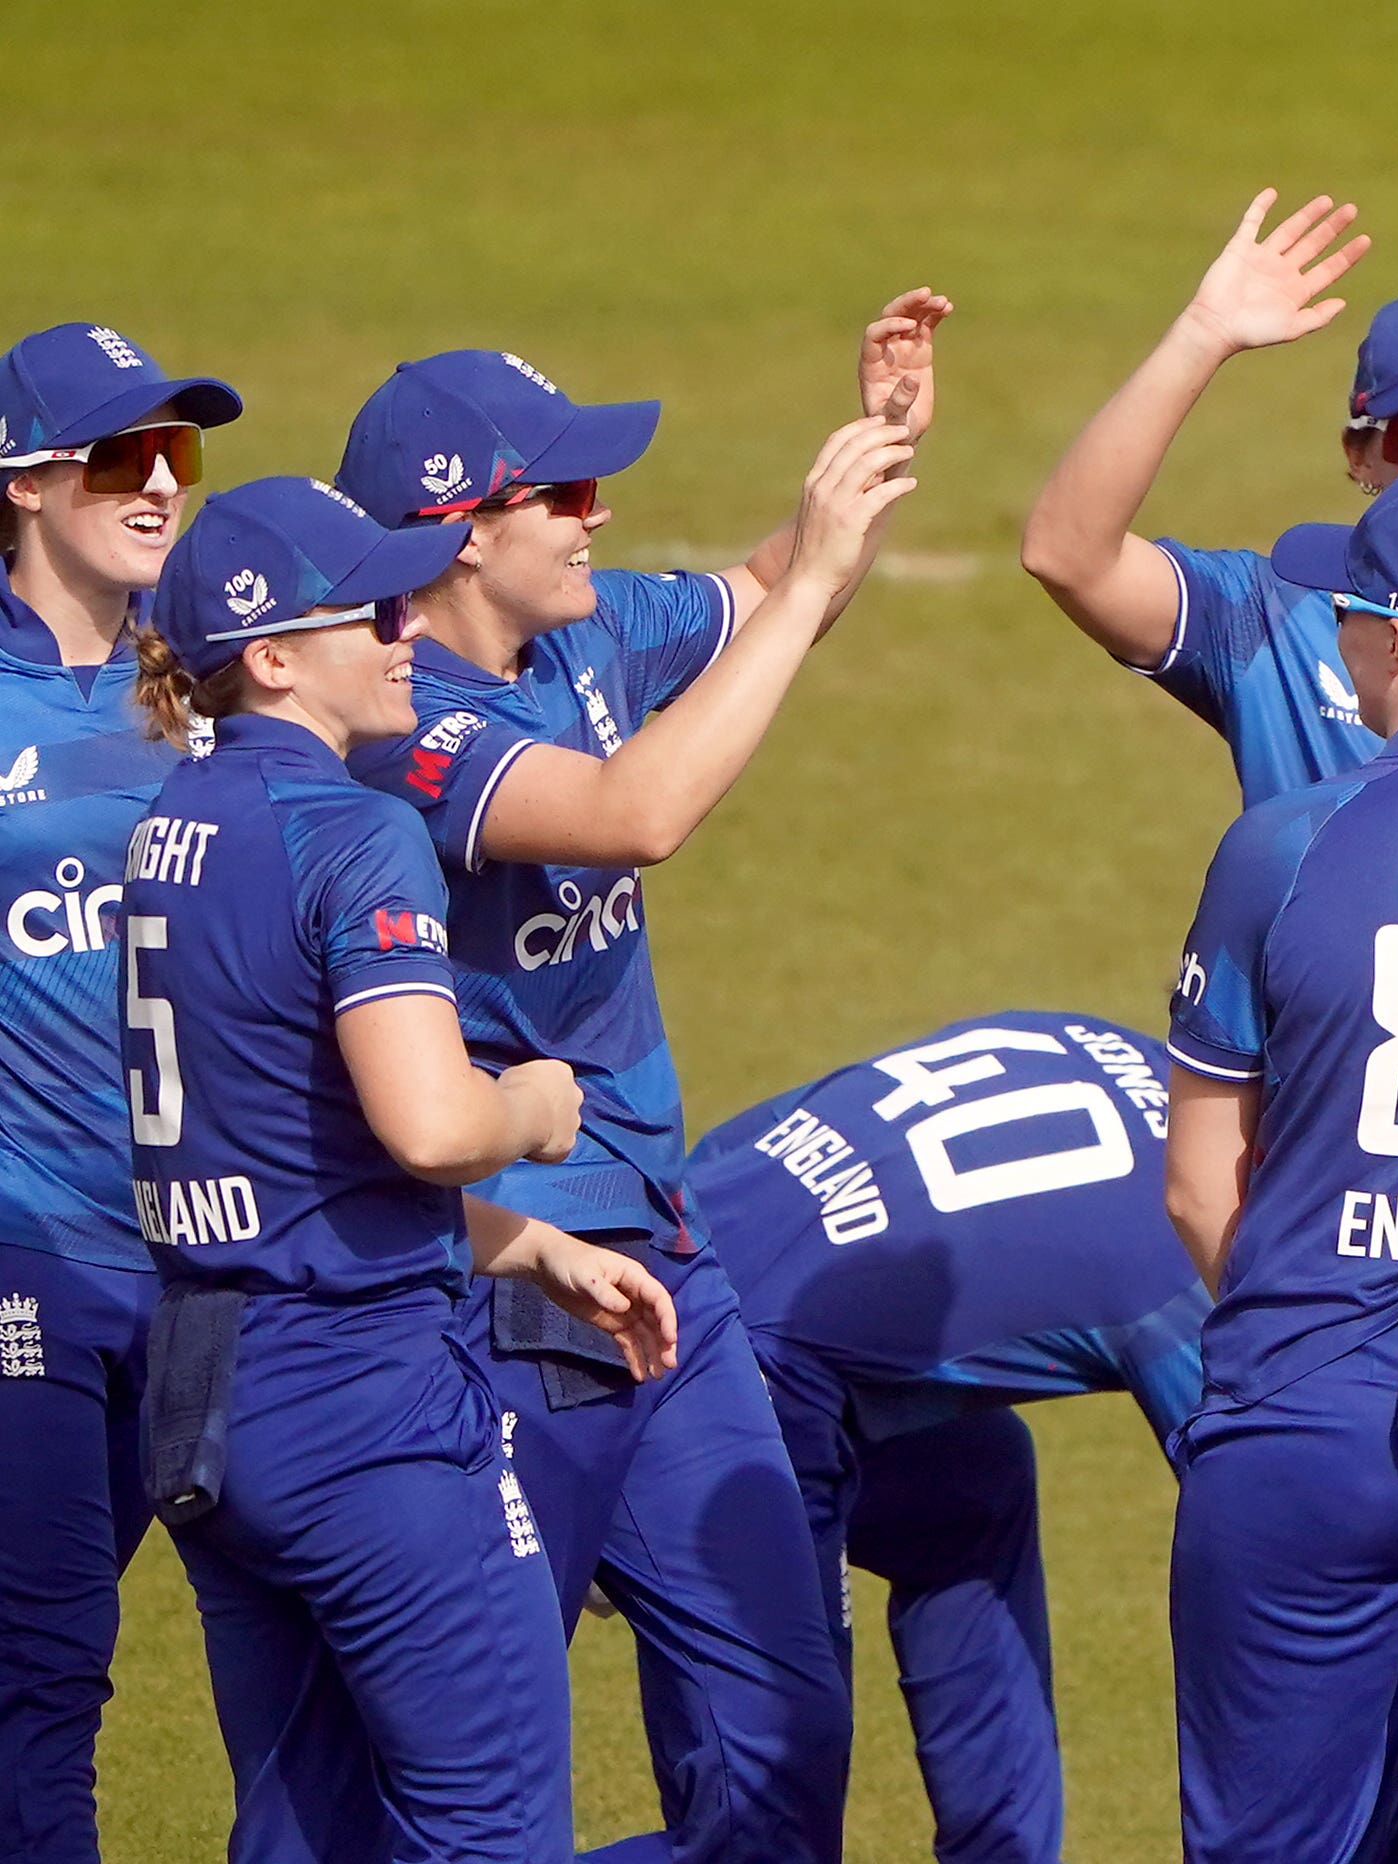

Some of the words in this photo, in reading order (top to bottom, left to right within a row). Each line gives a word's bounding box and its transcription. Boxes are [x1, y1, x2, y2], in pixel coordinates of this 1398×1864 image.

[424, 453, 448, 475] 50
[436, 477, 473, 505] CASTORE
[224, 568, 255, 597] 100
[241, 597, 277, 627] CASTORE
[406, 711, 479, 799] METRO
[126, 916, 185, 1147] 5
[872, 1027, 1135, 1213] 40
[754, 1107, 890, 1246] ENGLAND
